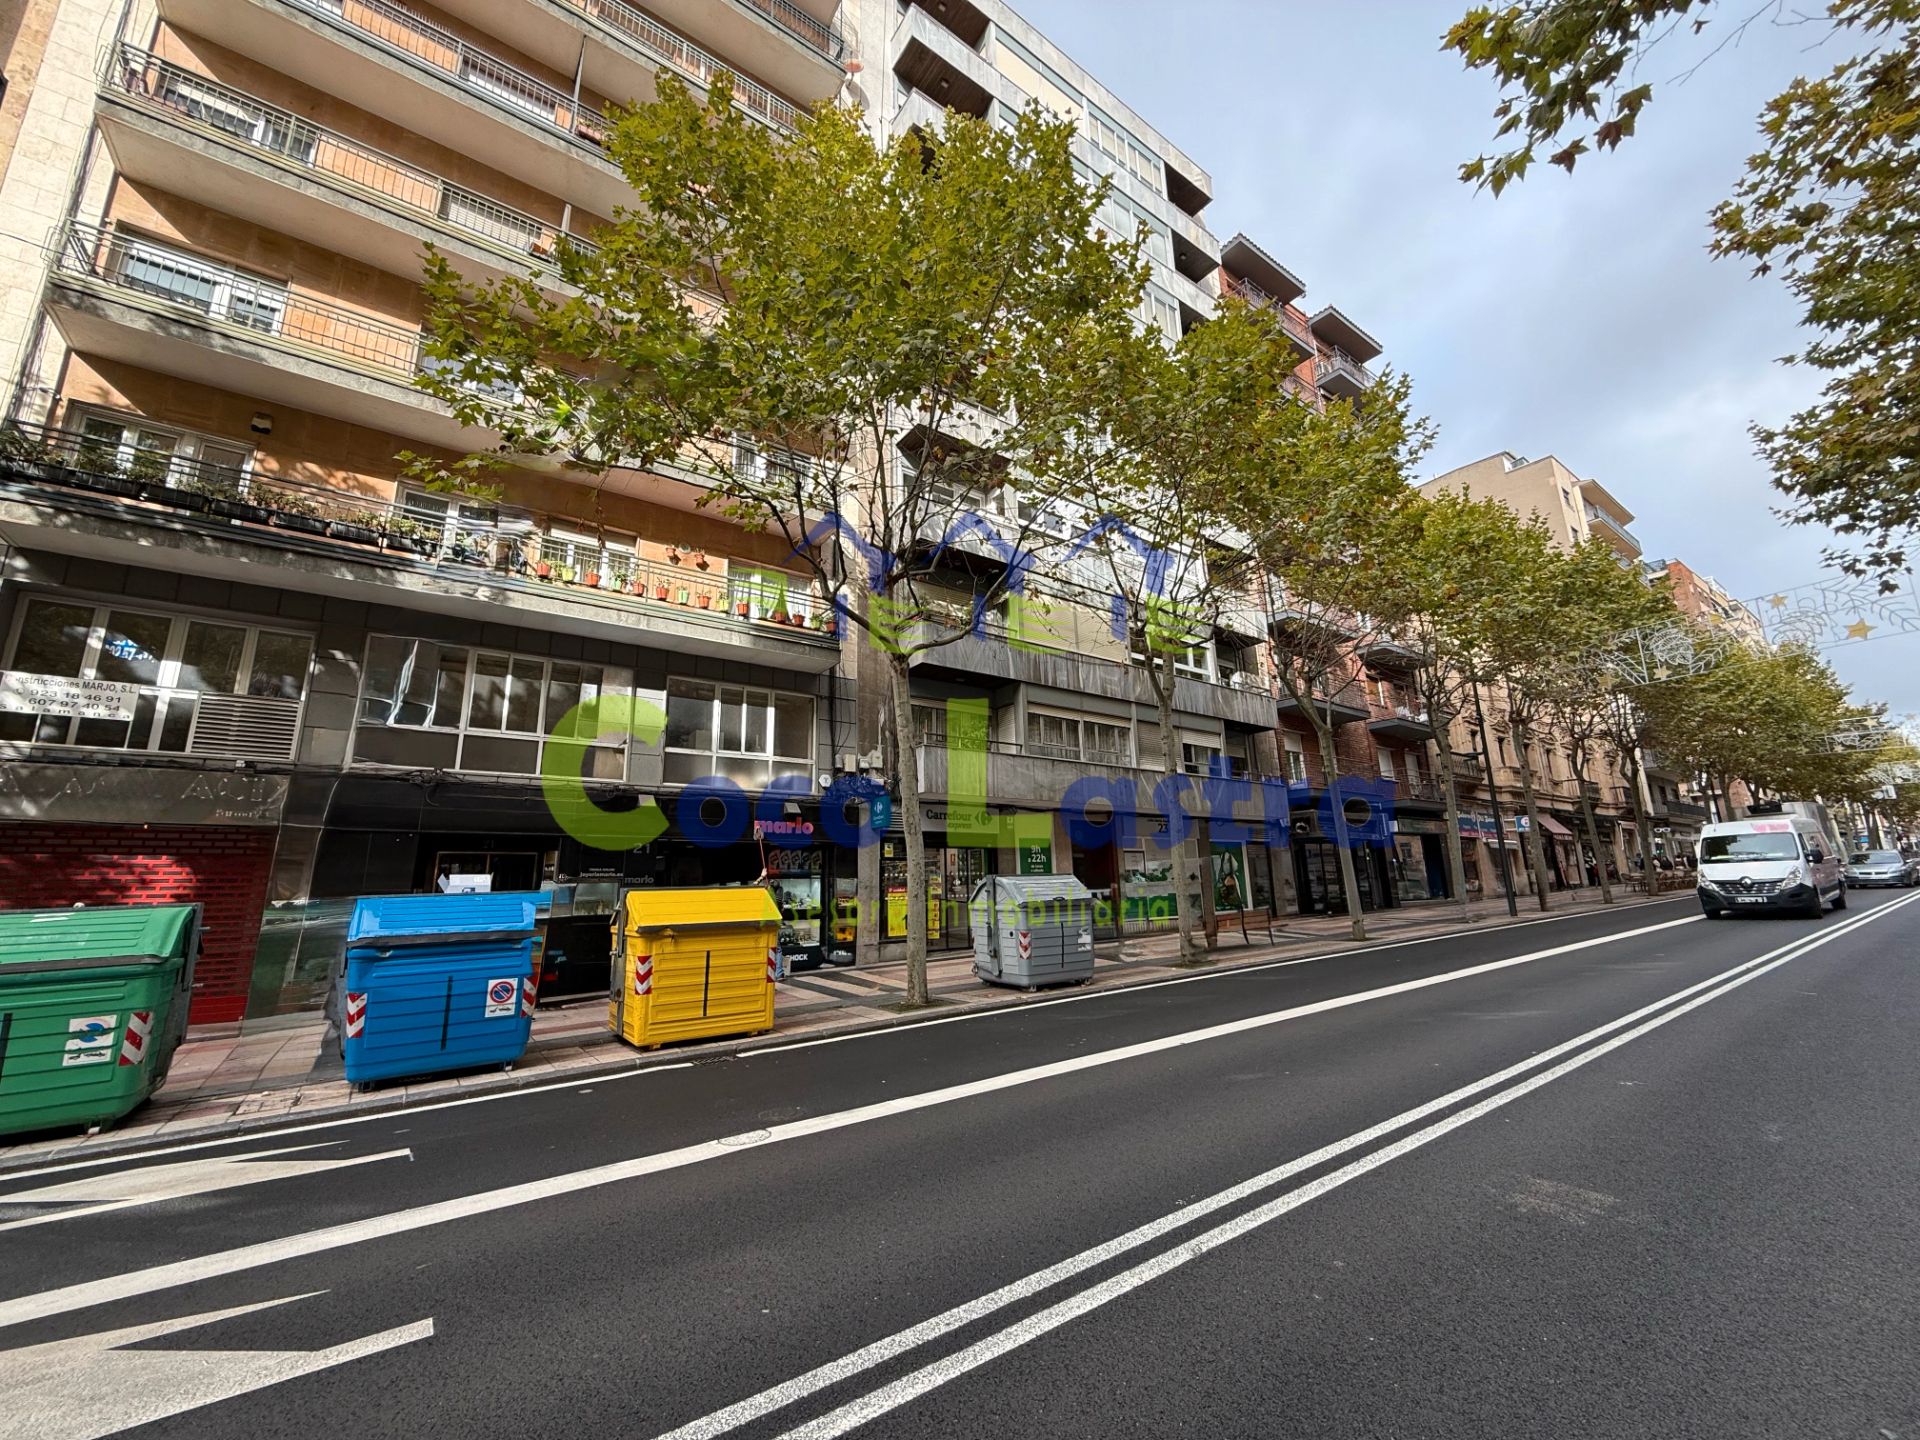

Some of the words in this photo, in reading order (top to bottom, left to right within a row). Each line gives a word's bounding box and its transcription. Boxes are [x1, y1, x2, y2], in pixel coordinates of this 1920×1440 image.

[82, 681, 118, 694] MARJO,
[30, 689, 58, 697] 923
[64, 692, 80, 700] 18
[84, 694, 102, 702] 46
[28, 697, 57, 706] 607
[60, 700, 79, 709] 97
[81, 702, 100, 710] 40
[104, 704, 121, 712] 54
[926, 808, 972, 821] Carrefour
[754, 816, 814, 835] mario
[1032, 854, 1047, 863] 22h
[786, 953, 809, 961] HOCK
